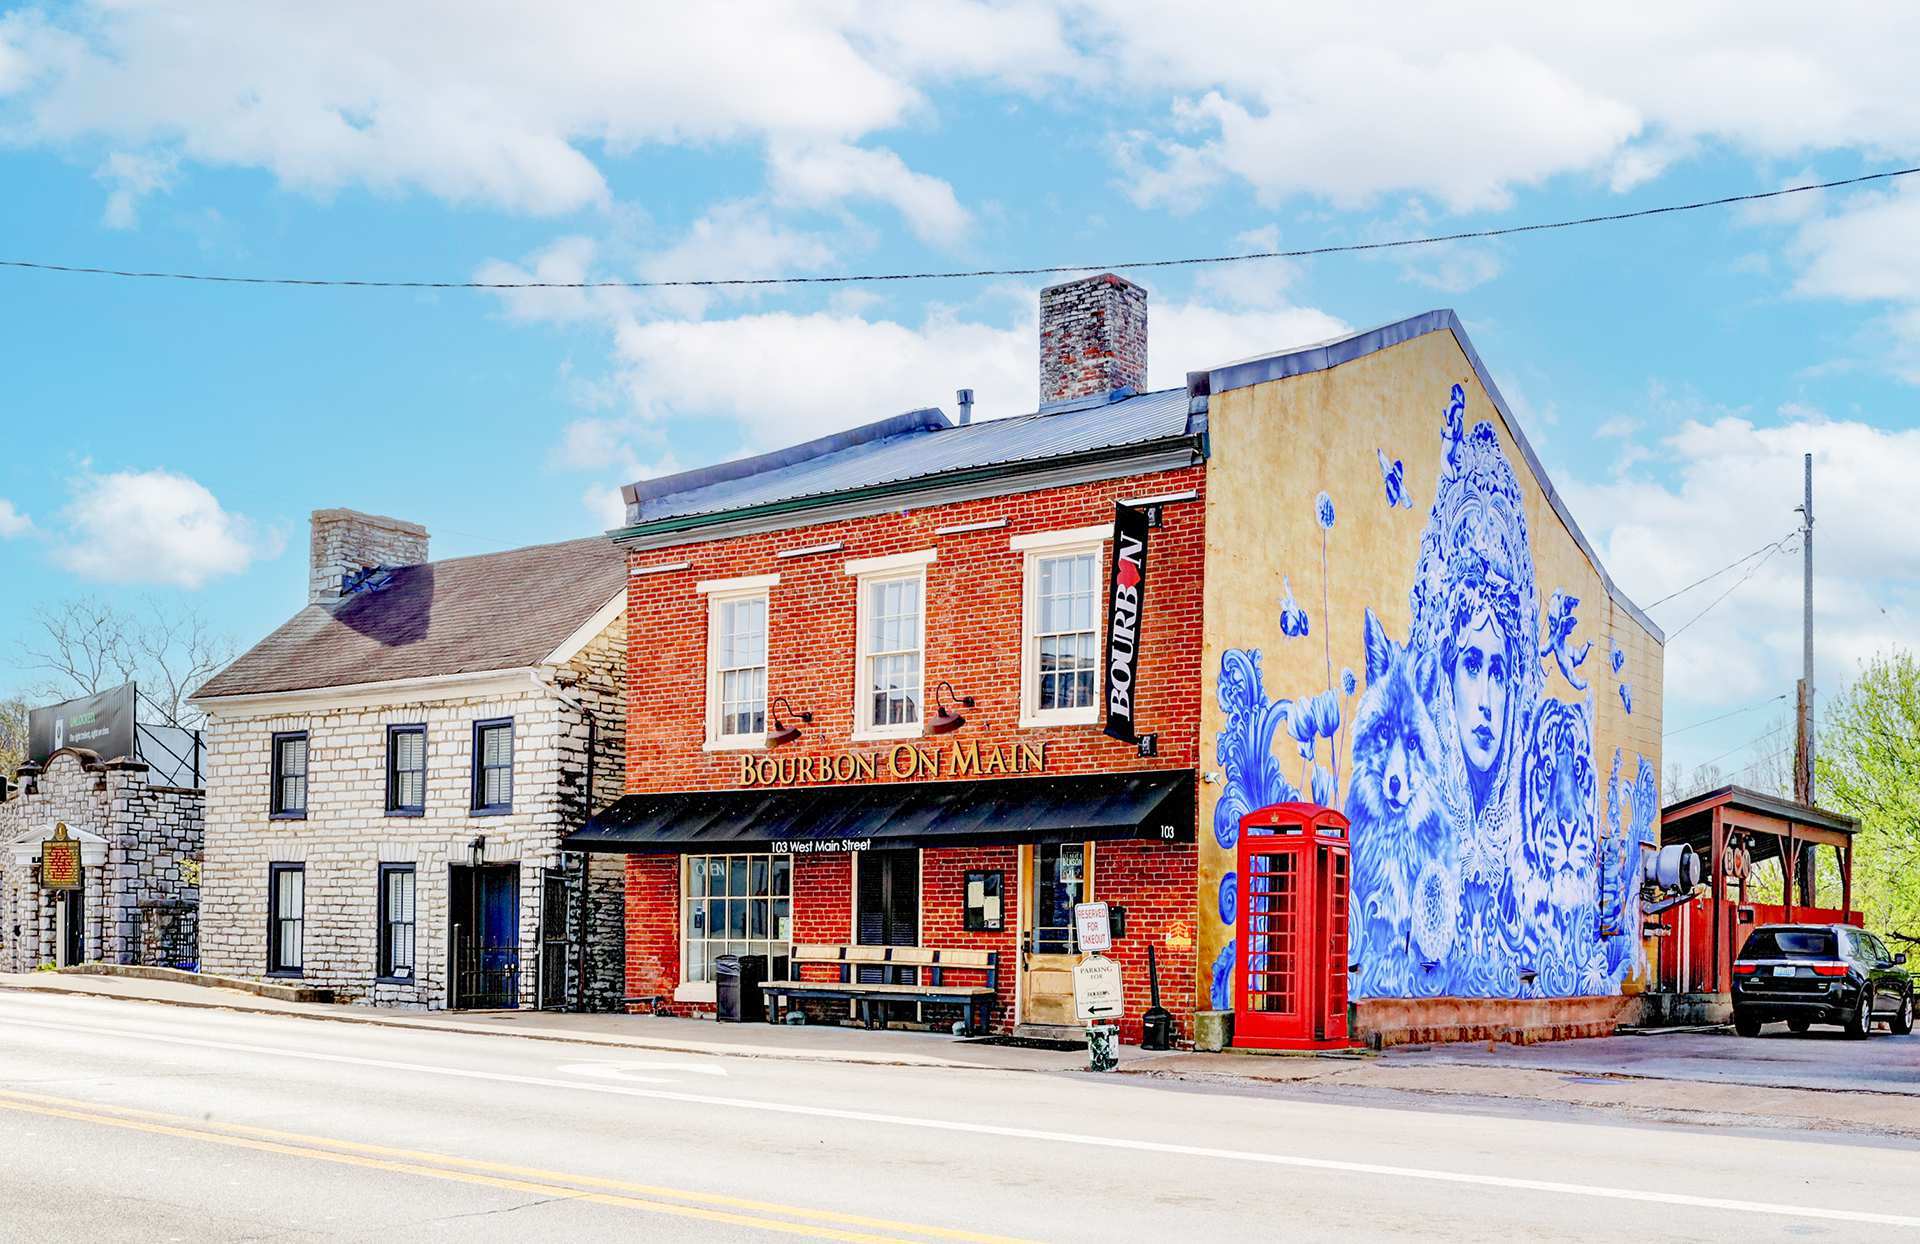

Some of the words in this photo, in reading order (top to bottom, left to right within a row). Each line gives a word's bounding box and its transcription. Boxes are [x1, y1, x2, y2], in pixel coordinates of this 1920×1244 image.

[738, 753, 879, 785] BOURBON
[888, 744, 940, 778] ON
[948, 740, 1045, 776] MAIN
[1160, 825, 1175, 839] 103
[771, 841, 788, 853] 103
[789, 841, 813, 853] West
[814, 839, 840, 852] Main
[841, 838, 871, 852] Street
[1078, 908, 1105, 920] RESERVED
[1087, 921, 1098, 932] FOR
[1082, 933, 1105, 945] TAKEOUT
[1080, 966, 1113, 974] PARKING
